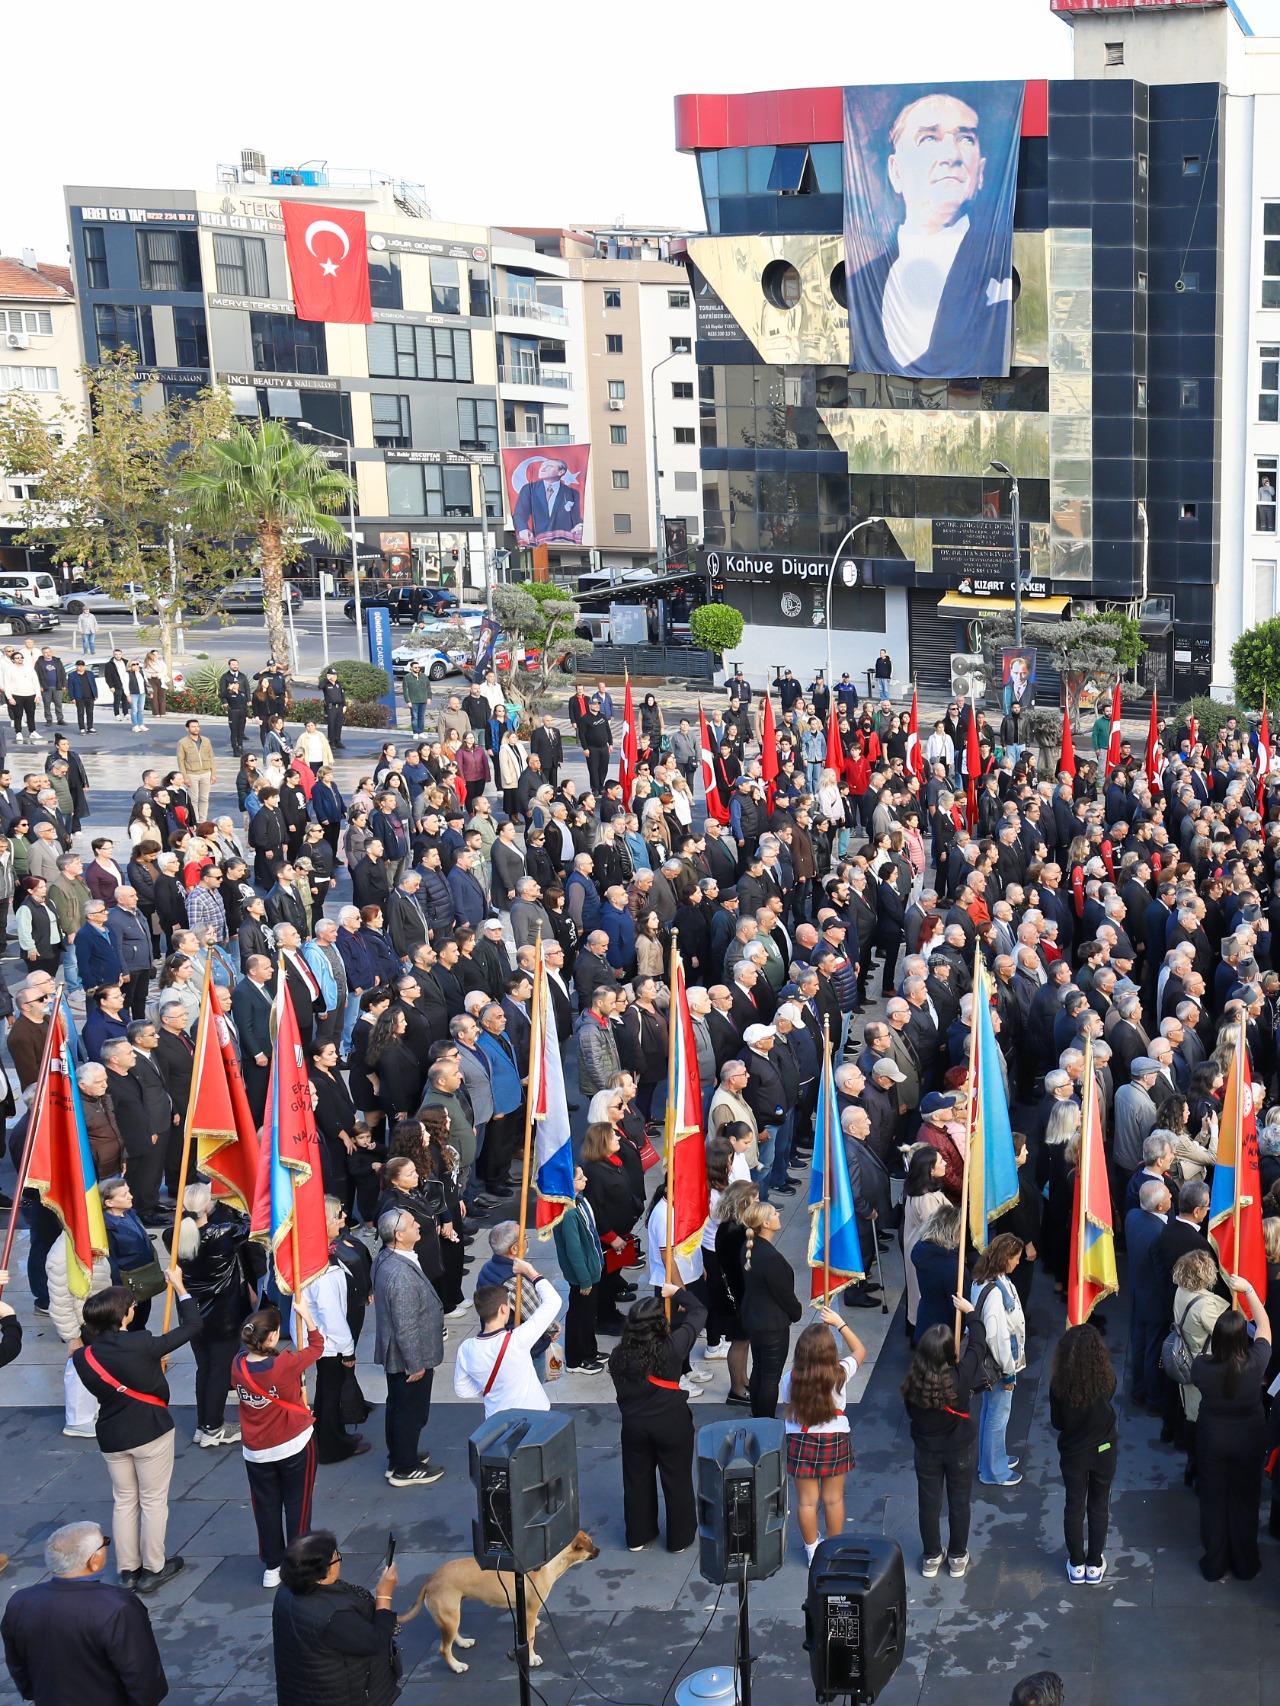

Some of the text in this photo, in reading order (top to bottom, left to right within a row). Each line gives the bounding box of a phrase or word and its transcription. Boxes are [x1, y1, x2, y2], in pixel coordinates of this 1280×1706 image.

[212, 298, 249, 308] MERVE
[253, 377, 285, 387] BEAUTY
[286, 379, 293, 387] &
[974, 580, 1004, 591] KIZART
